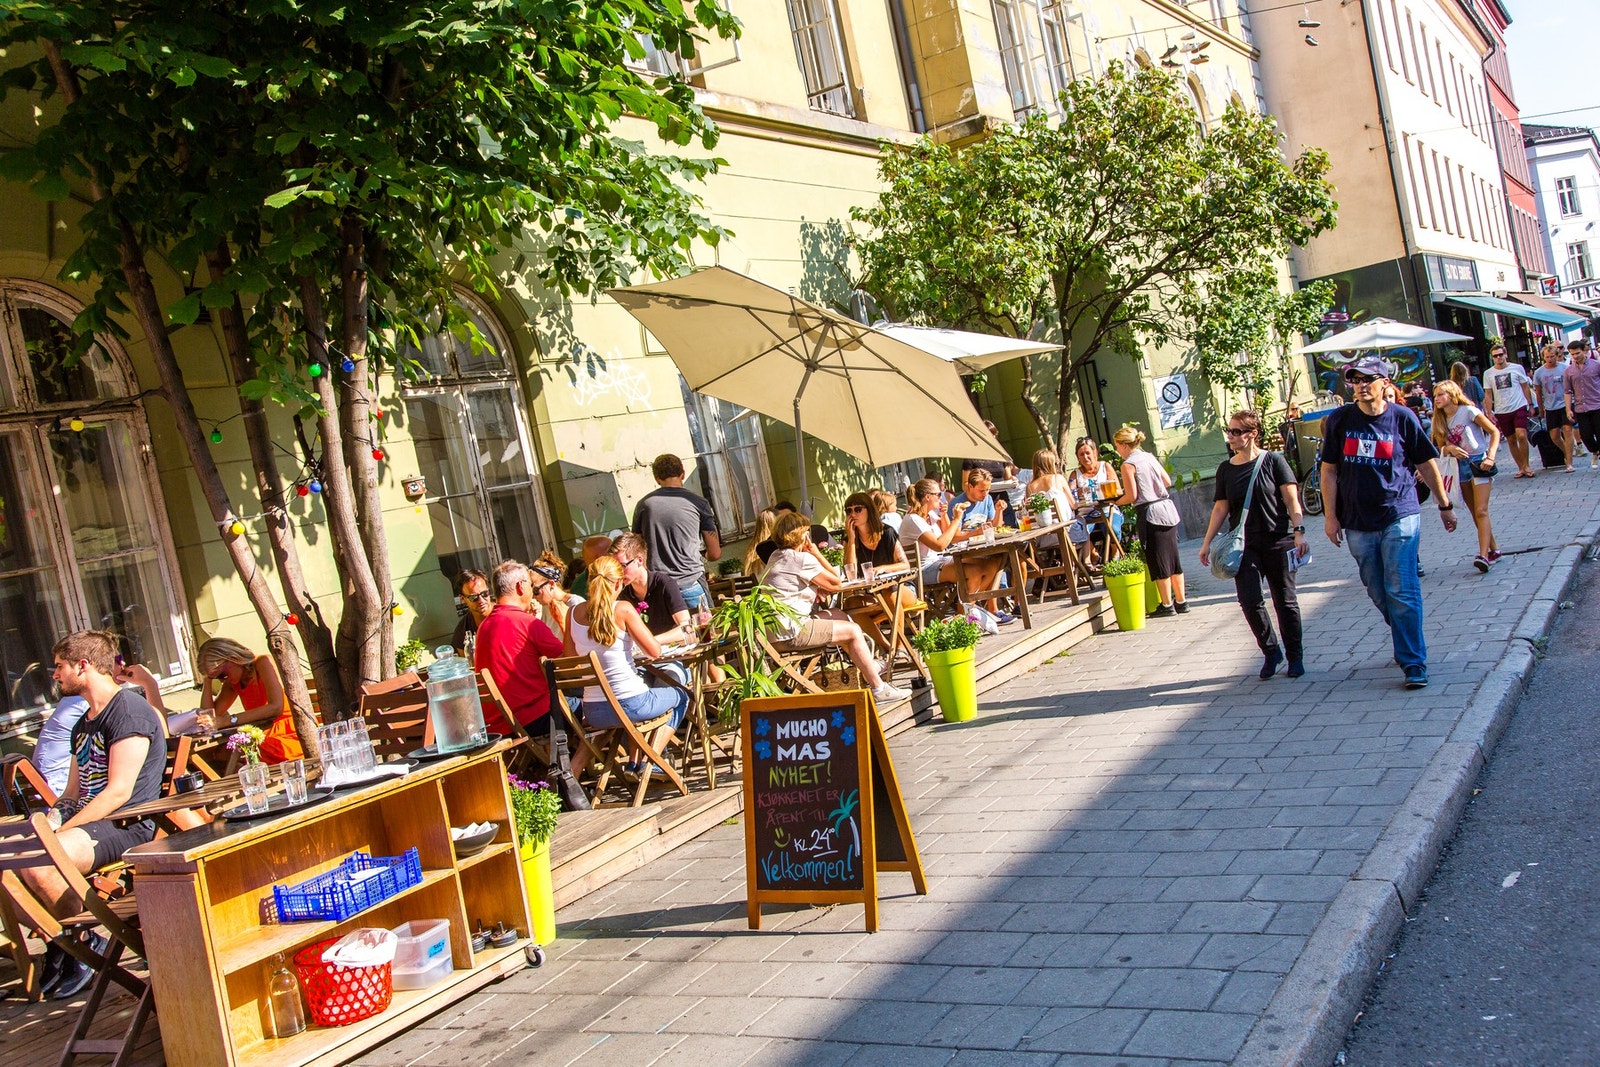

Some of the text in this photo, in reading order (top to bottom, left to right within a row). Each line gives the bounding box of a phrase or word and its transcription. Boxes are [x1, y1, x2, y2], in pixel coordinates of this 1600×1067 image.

[1345, 431, 1393, 442] VIENNA
[1344, 456, 1389, 466] AUSTRIA
[776, 718, 828, 740] MUCHO
[777, 741, 831, 762] MAS
[769, 761, 831, 789] NYHET!
[758, 788, 840, 808] KJØKKENET ER
[766, 808, 828, 828] ÅPENT TIL
[761, 844, 855, 884] Velkommen!
